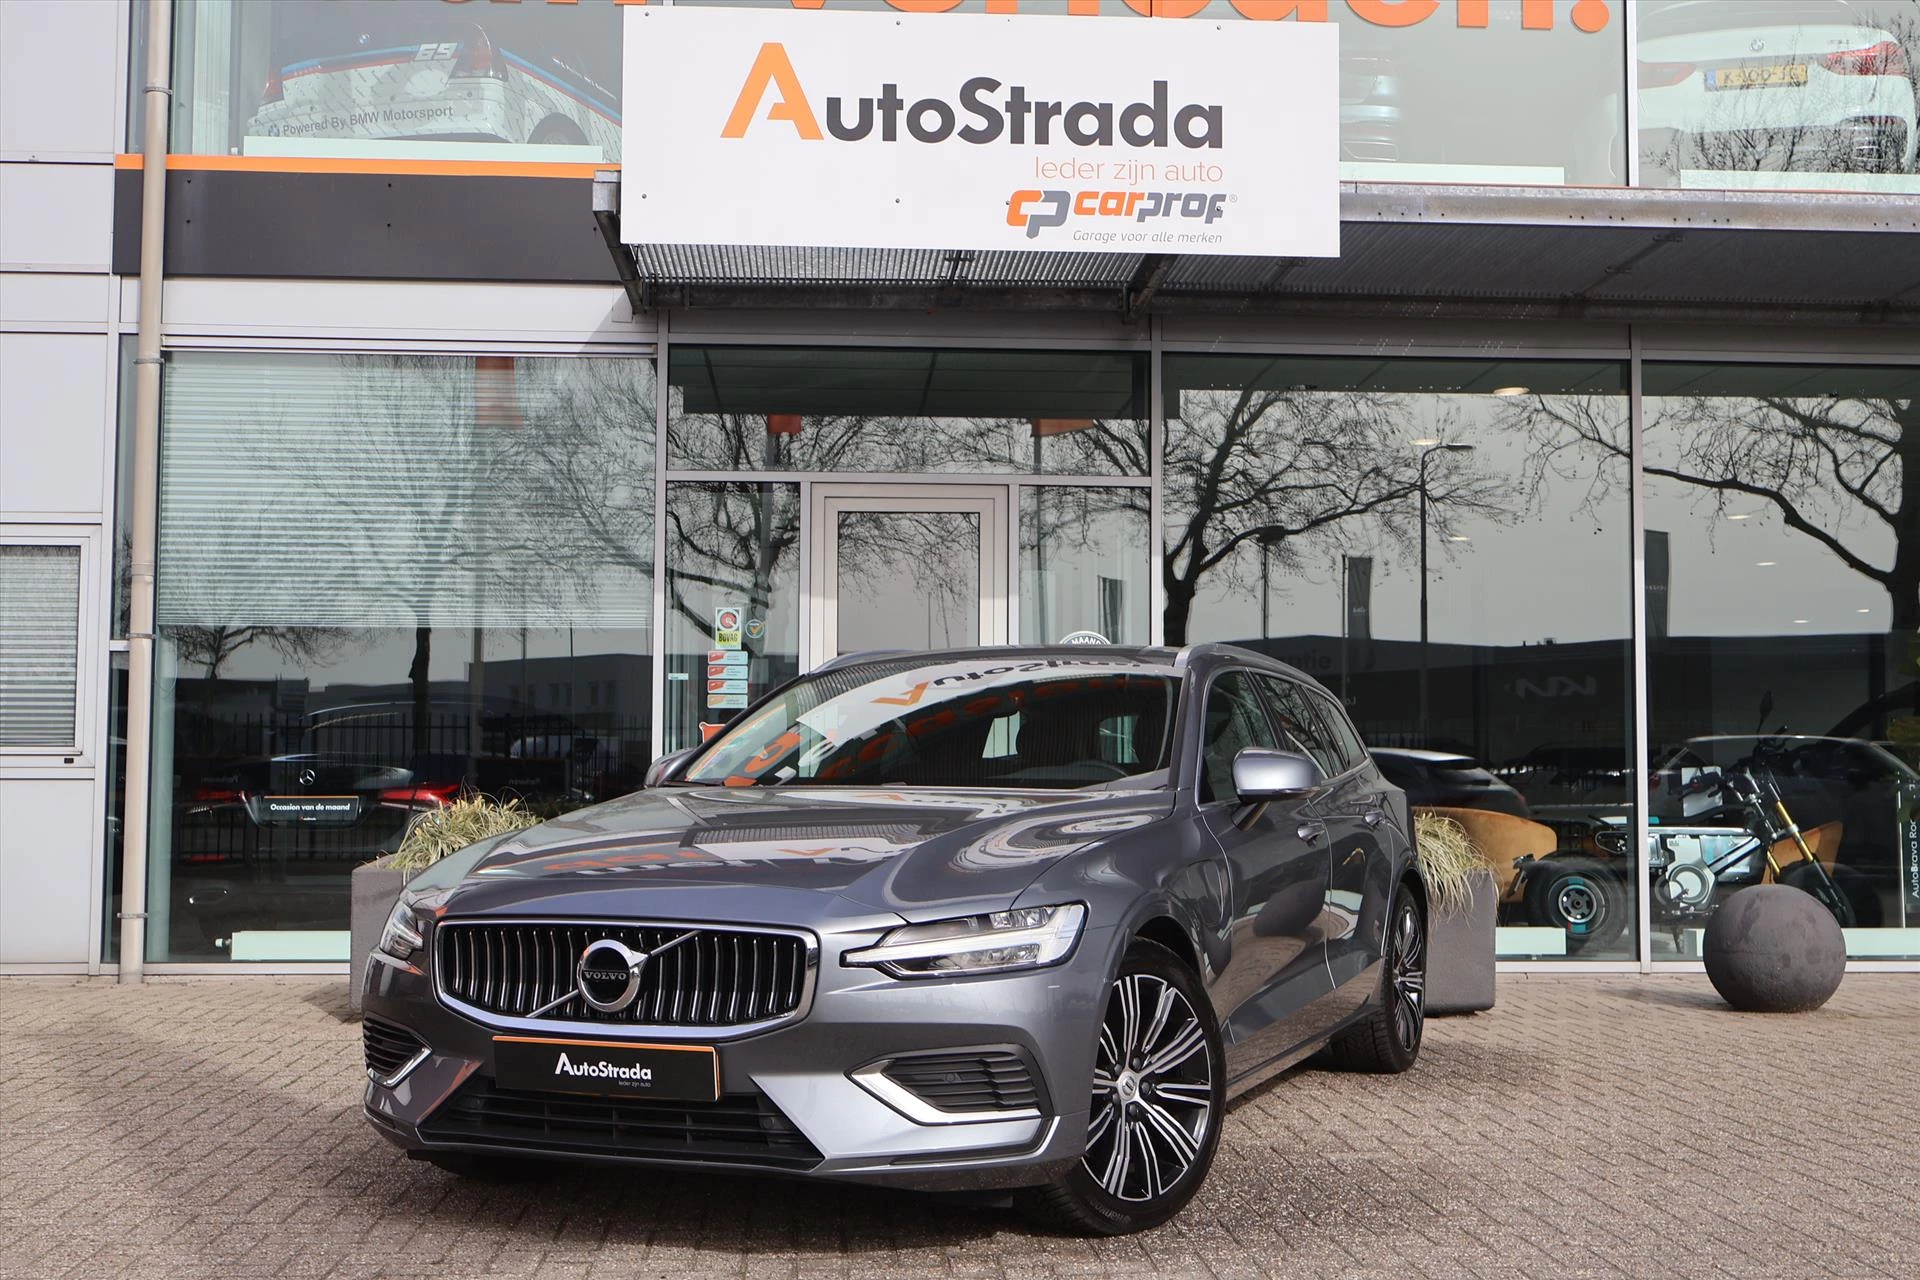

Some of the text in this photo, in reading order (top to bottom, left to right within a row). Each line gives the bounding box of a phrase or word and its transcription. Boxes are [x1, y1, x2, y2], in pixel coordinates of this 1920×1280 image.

[720, 42, 1223, 149] AutoStrada
[283, 106, 454, 136] Powered By BMW Motorsport
[1035, 156, 1223, 186] Ieder zijn auto
[1073, 191, 1227, 225] carprof
[1073, 230, 1223, 244] Garage voor alle merken
[718, 632, 738, 643] BOVAG
[270, 803, 300, 811] Occasion
[315, 802, 324, 811] de
[325, 802, 351, 811] maand
[1910, 841, 1920, 898] AutoBrava
[583, 970, 627, 981] VOLVO
[554, 1052, 652, 1081] AutoStrada
